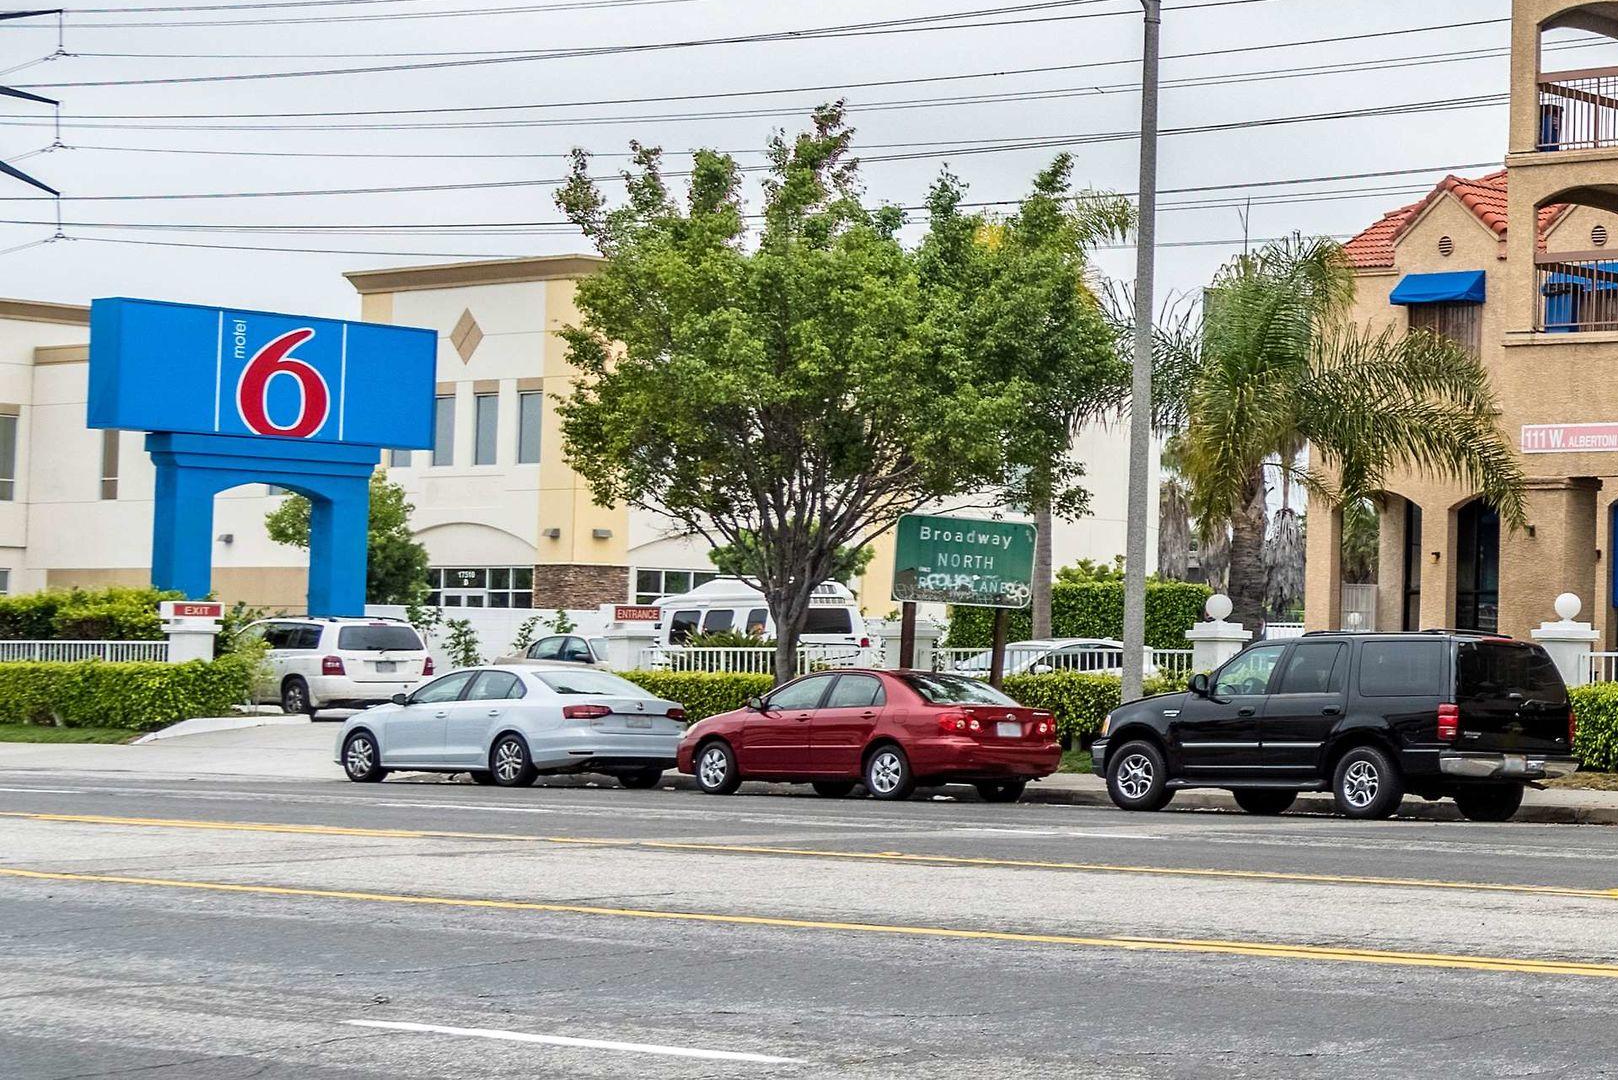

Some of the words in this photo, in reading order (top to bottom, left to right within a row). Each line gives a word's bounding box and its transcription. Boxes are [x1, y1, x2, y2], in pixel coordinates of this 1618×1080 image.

[233, 319, 247, 359] motel
[235, 327, 331, 438] 6
[1526, 430, 1546, 448] 111
[1549, 428, 1566, 448] W.
[1568, 434, 1617, 448] ALBERTONI
[920, 526, 1012, 549] Broadway
[937, 553, 994, 570] NORTH
[184, 606, 210, 615] EXIT
[617, 608, 659, 619] ENTRANCE
